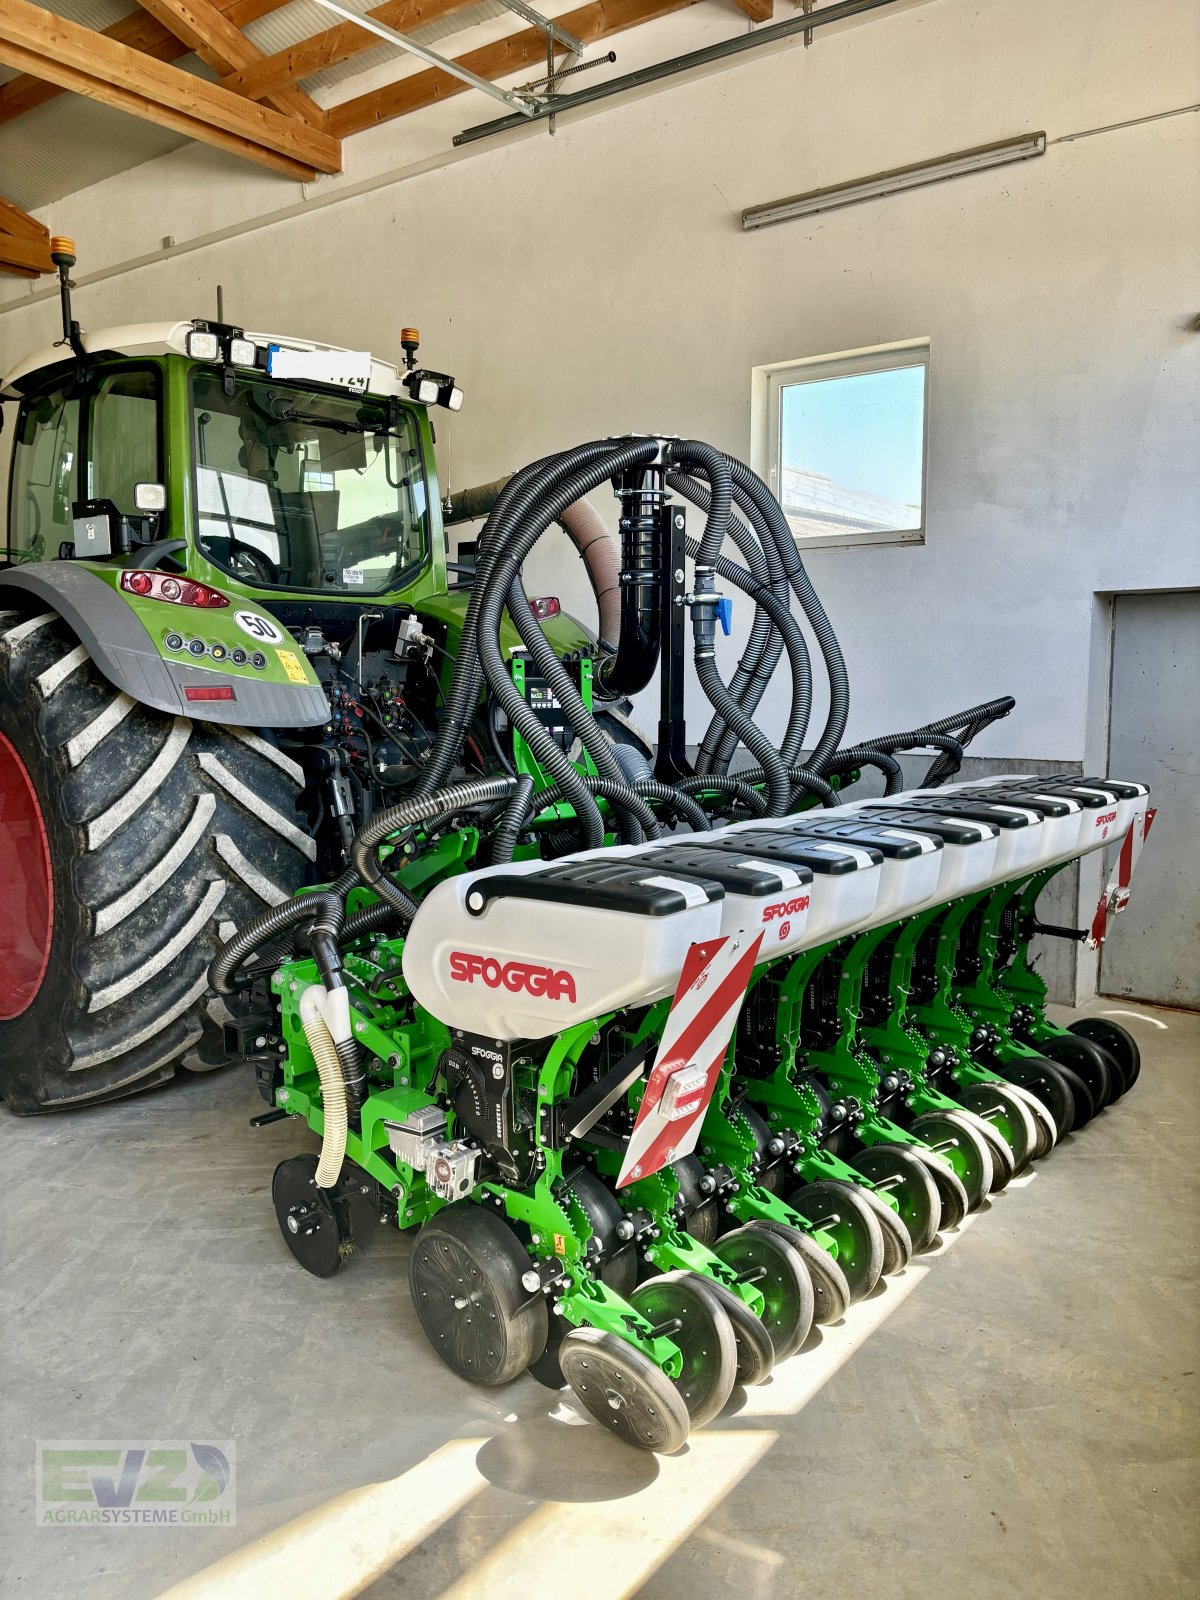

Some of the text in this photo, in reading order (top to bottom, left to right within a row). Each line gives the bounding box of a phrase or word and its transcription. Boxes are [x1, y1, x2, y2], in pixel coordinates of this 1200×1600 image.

[240, 615, 277, 638] 50
[762, 895, 810, 922] SFOGGIA
[449, 951, 577, 1003] SFOGGIA
[471, 1046, 503, 1063] SFOGGIA
